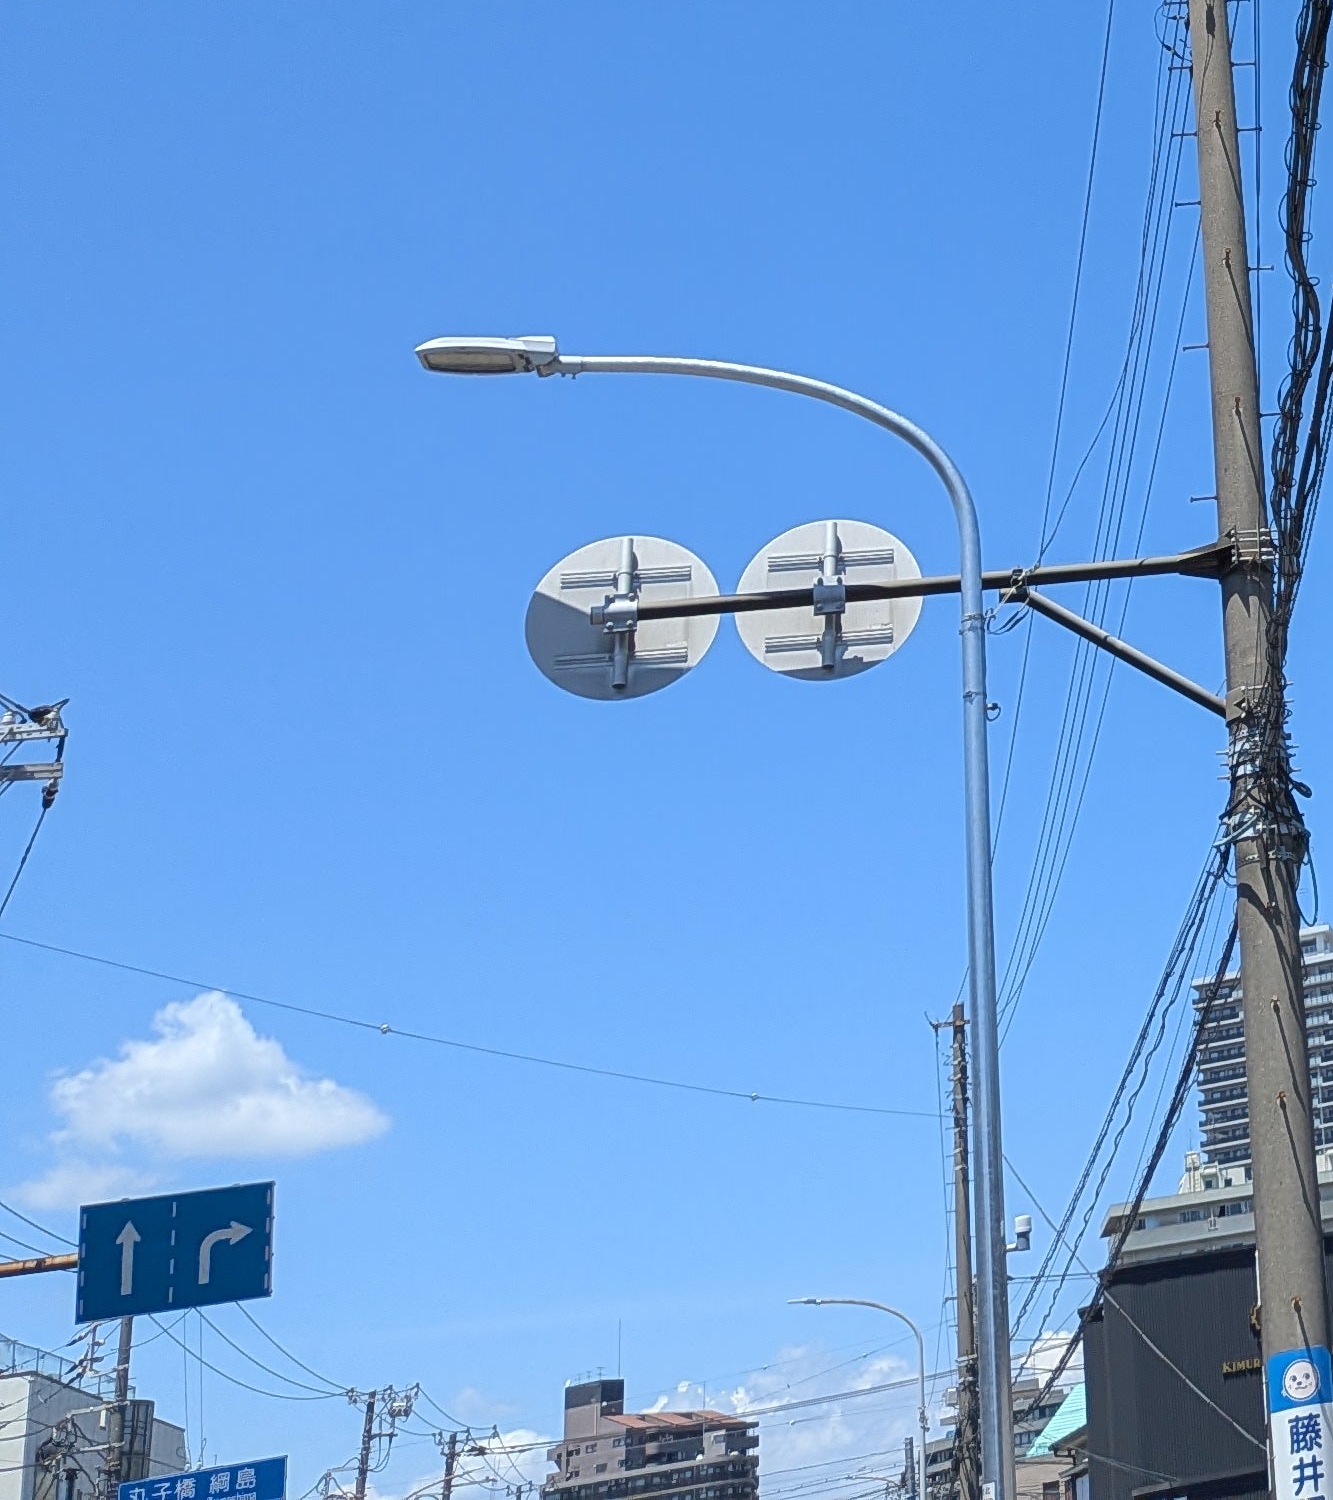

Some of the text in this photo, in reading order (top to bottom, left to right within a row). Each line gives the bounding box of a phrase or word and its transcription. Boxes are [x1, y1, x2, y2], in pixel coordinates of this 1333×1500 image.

[129, 1466, 257, 1500] 丸子橋 綱島
[1287, 1411, 1325, 1500] 藤井
